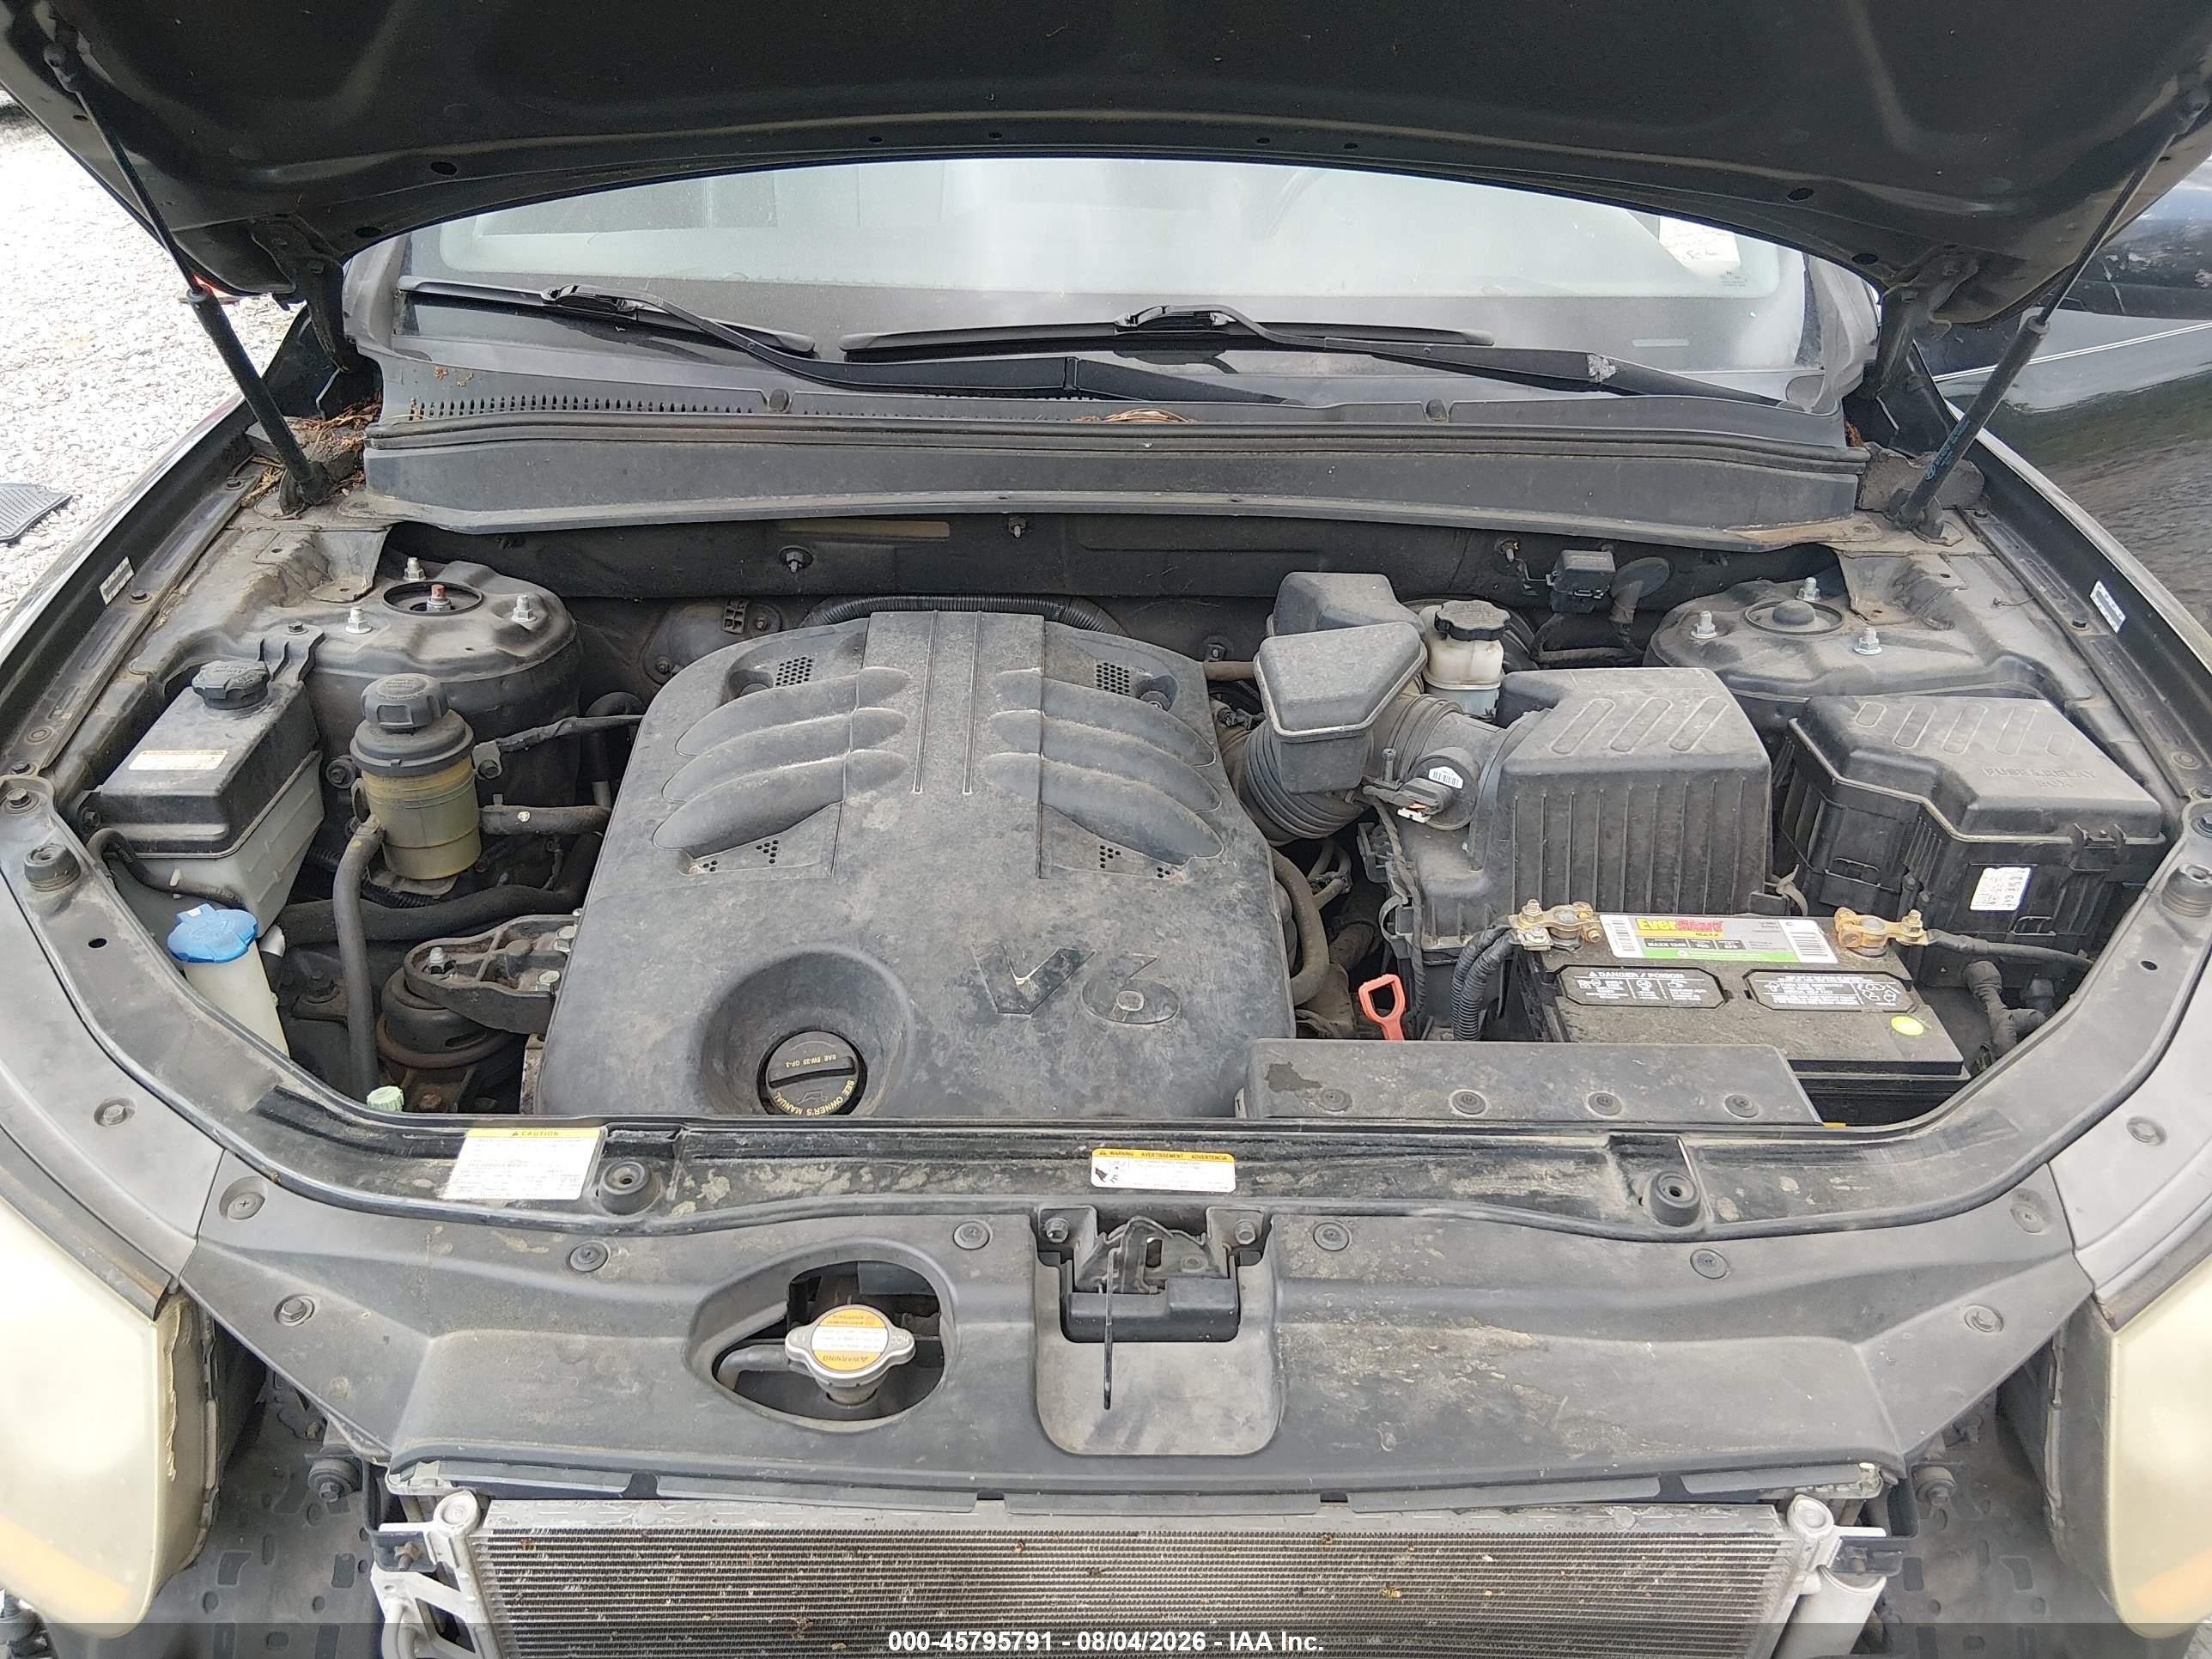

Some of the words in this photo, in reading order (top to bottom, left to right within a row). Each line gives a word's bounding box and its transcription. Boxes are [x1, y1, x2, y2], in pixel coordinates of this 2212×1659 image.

[1635, 917, 1724, 933] EverStart
[841, 1079, 855, 1097] SEE
[773, 1091, 803, 1115] MANUAL
[806, 1096, 843, 1116] OWNER'S
[822, 1354, 860, 1363] WARNING
